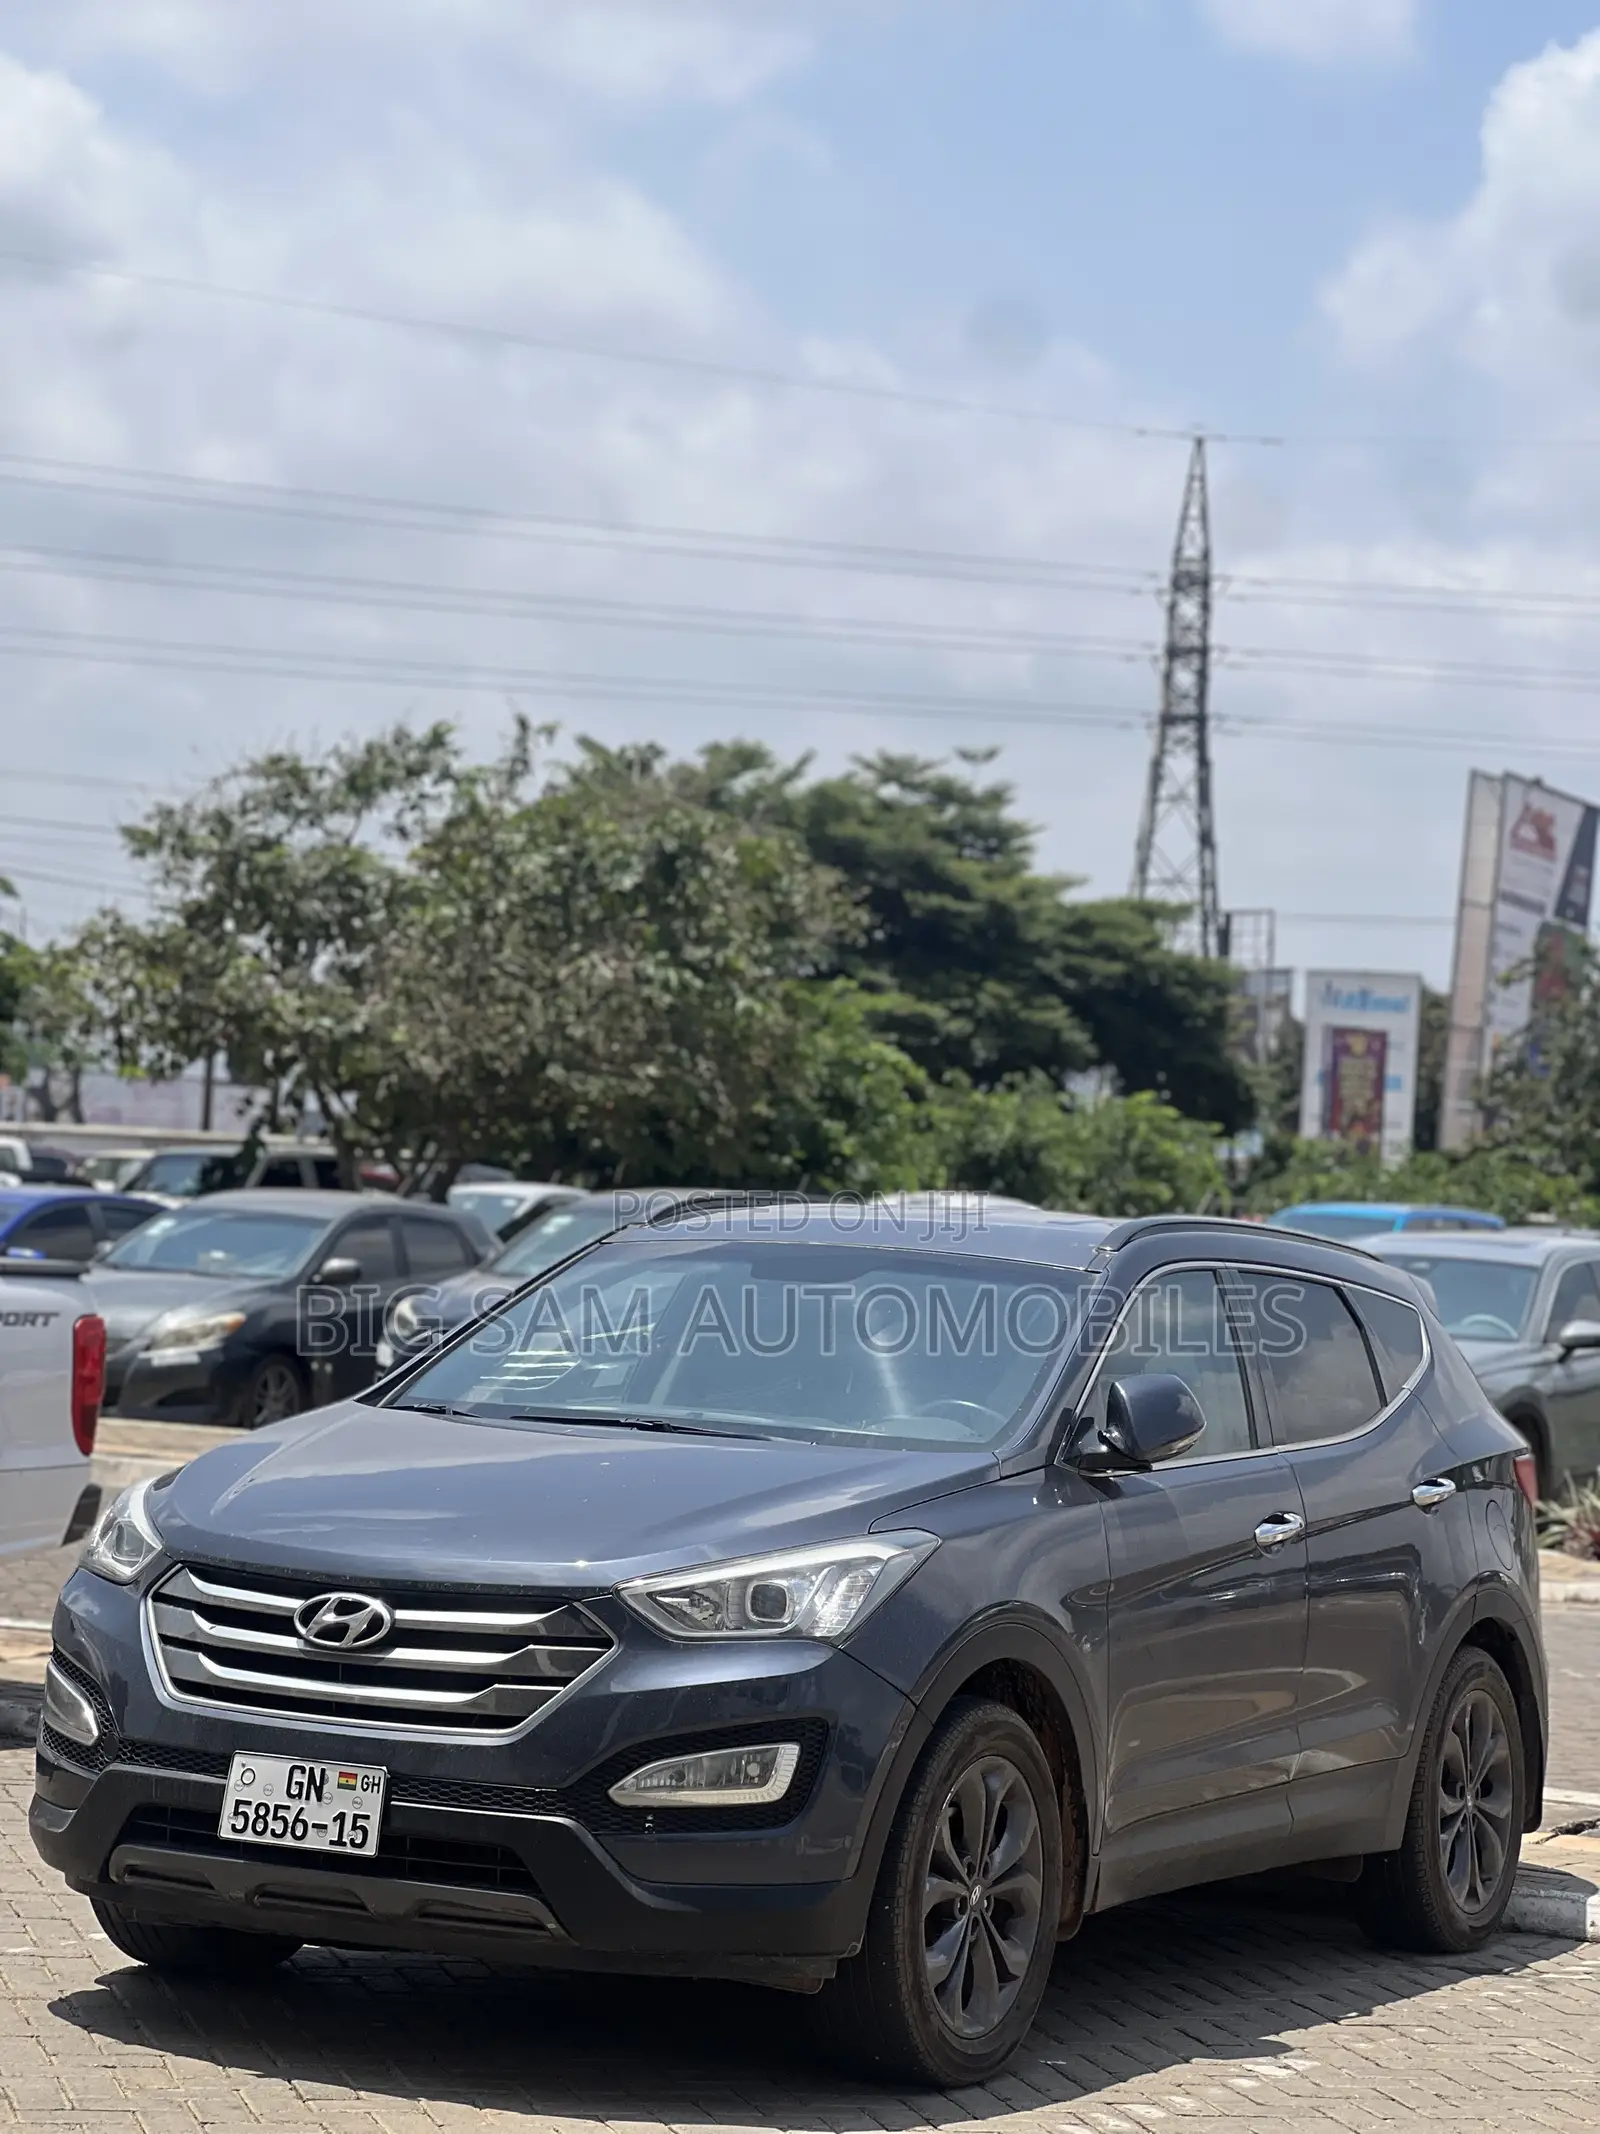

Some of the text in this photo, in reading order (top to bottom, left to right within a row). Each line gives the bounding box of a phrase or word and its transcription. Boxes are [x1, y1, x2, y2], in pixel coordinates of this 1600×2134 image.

[0, 1311, 60, 1327] ORT
[286, 1764, 381, 1803] GN GH
[231, 1799, 371, 1849] 5856-15
